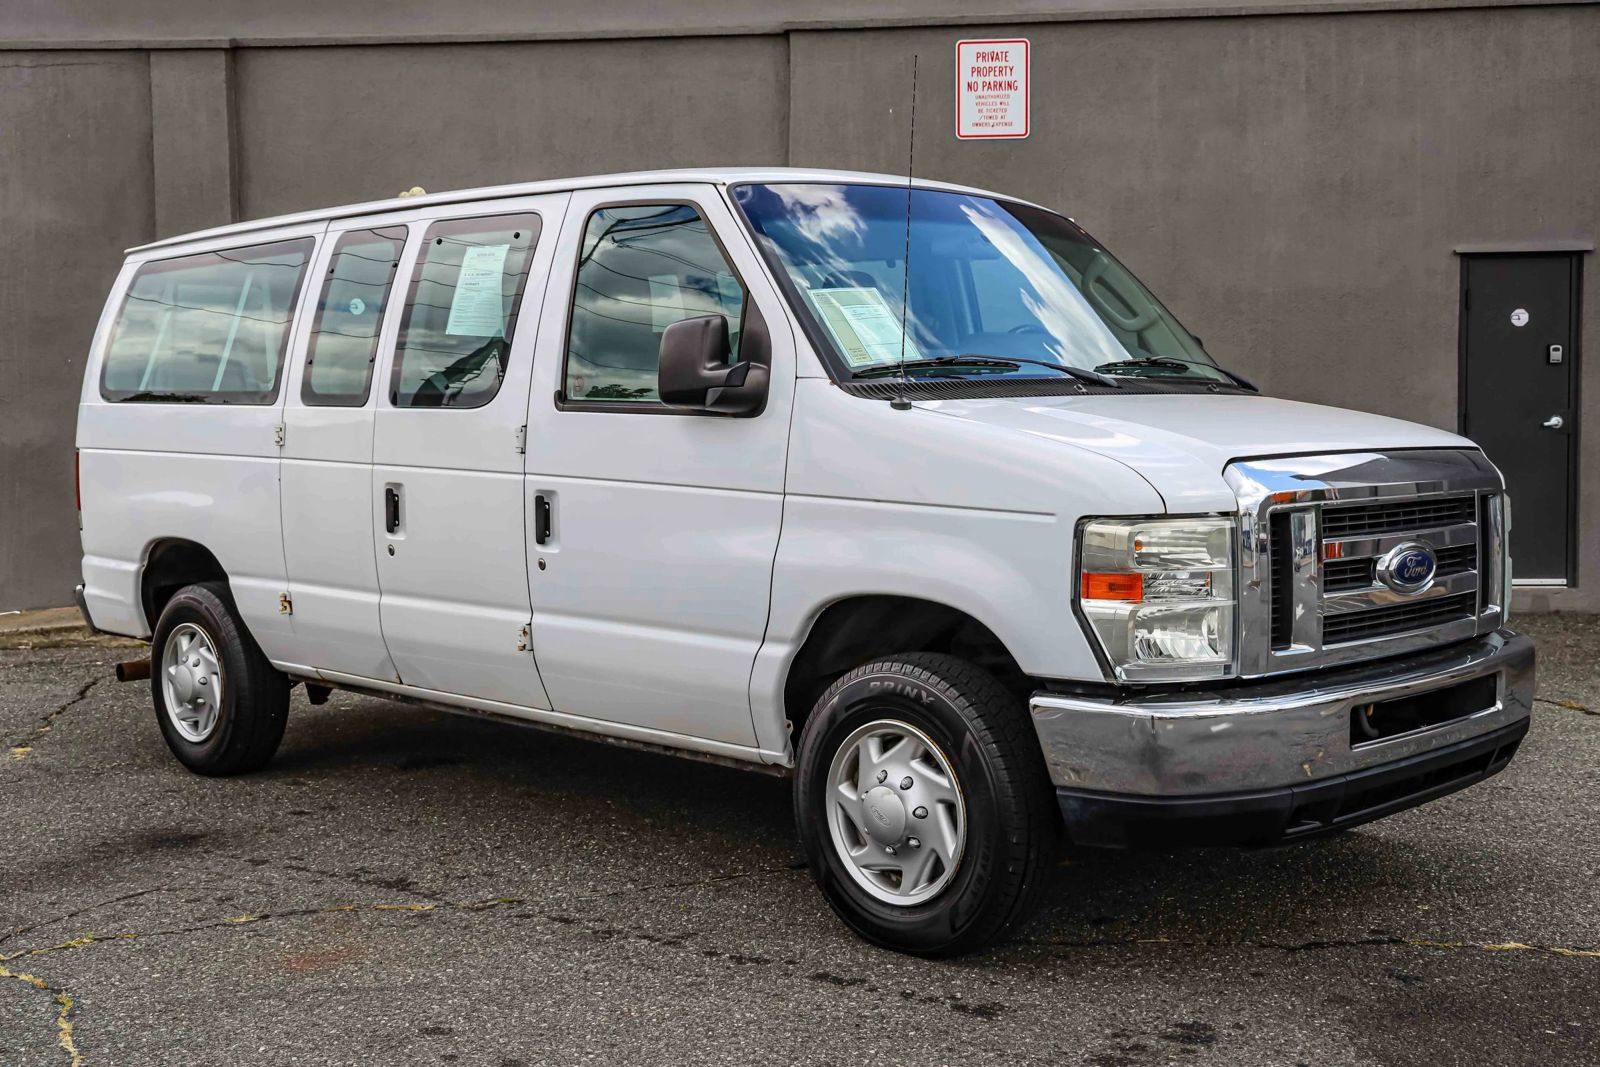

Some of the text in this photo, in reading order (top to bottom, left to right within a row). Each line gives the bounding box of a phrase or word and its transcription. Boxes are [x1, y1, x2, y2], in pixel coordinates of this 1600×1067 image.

[976, 51, 1010, 63] PRIVATE
[971, 65, 1015, 78] PROPERTY
[967, 80, 1018, 92] NO PARKING
[1404, 556, 1428, 578] Ford
